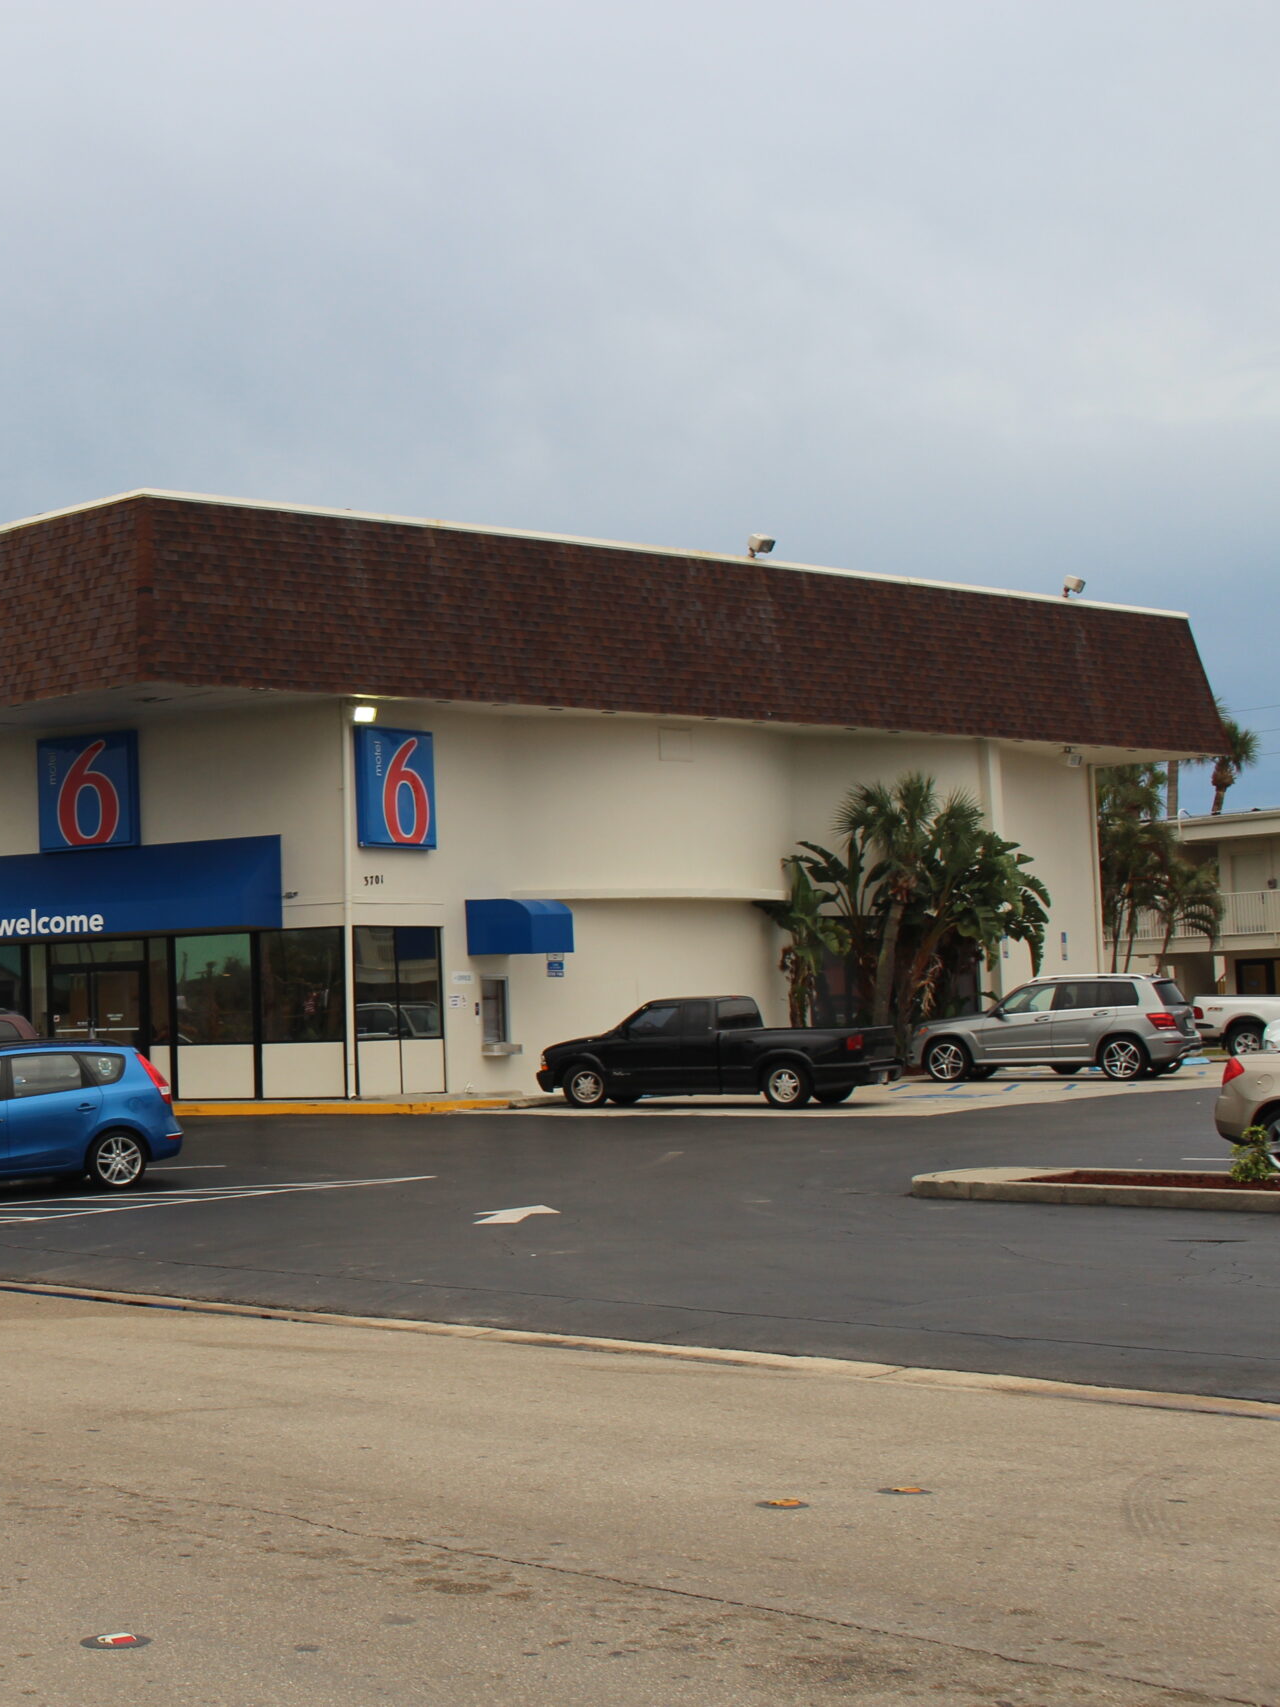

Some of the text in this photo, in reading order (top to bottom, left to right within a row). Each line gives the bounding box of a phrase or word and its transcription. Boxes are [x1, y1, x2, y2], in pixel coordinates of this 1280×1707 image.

[57, 739, 119, 846] 6
[374, 737, 430, 844] motel 6
